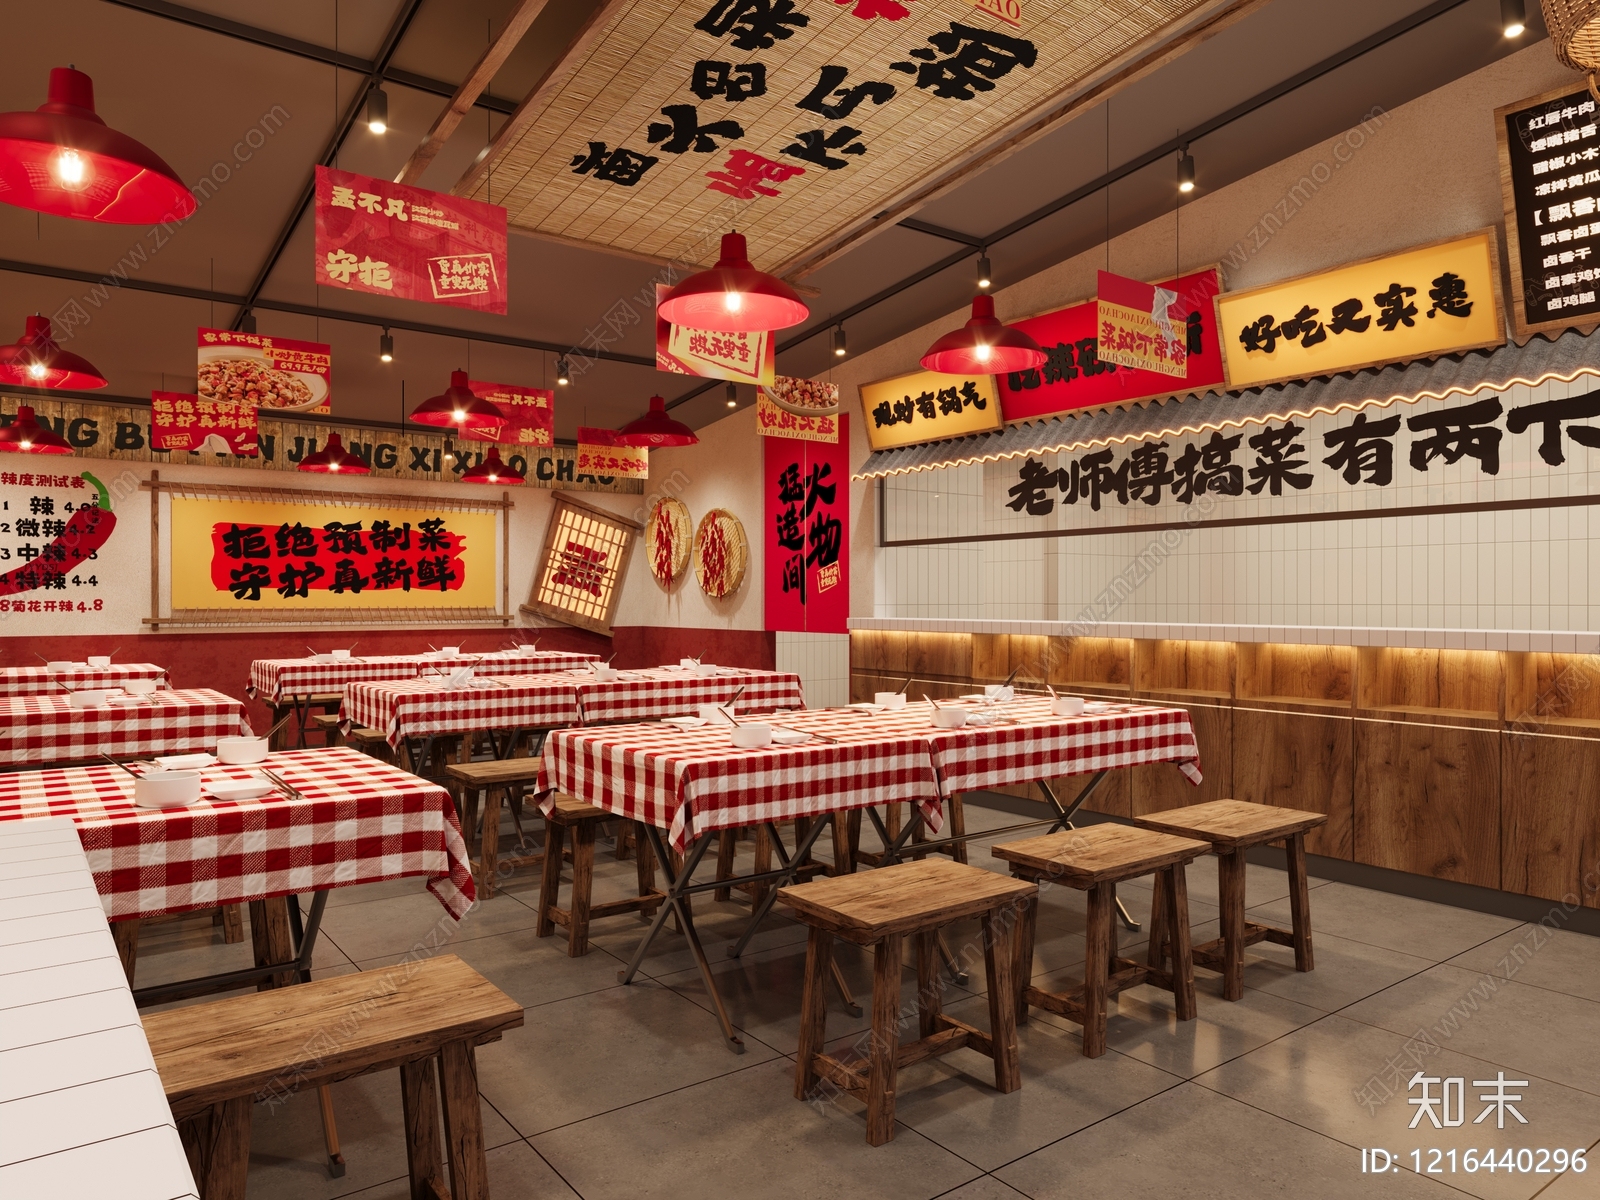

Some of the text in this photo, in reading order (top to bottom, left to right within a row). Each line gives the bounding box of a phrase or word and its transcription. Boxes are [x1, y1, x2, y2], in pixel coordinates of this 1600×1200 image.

[1532, 146, 1600, 176] 醋椒小木
[331, 185, 408, 221] 孟不凡
[1543, 247, 1592, 268] 卤香干
[1239, 272, 1473, 353] 好吃又实惠
[155, 413, 257, 429] 守护真新鲜
[409, 446, 442, 473] XI
[1, 472, 85, 489] 辣度测试表
[30, 496, 55, 515] 辣
[16, 518, 66, 538] 微辣
[222, 517, 451, 559] 拒绝预制菜
[17, 543, 66, 562] 中辣
[15, 571, 66, 590] 特辣
[71, 575, 98, 587] 4.4
[228, 554, 457, 601] 守护真新鲜
